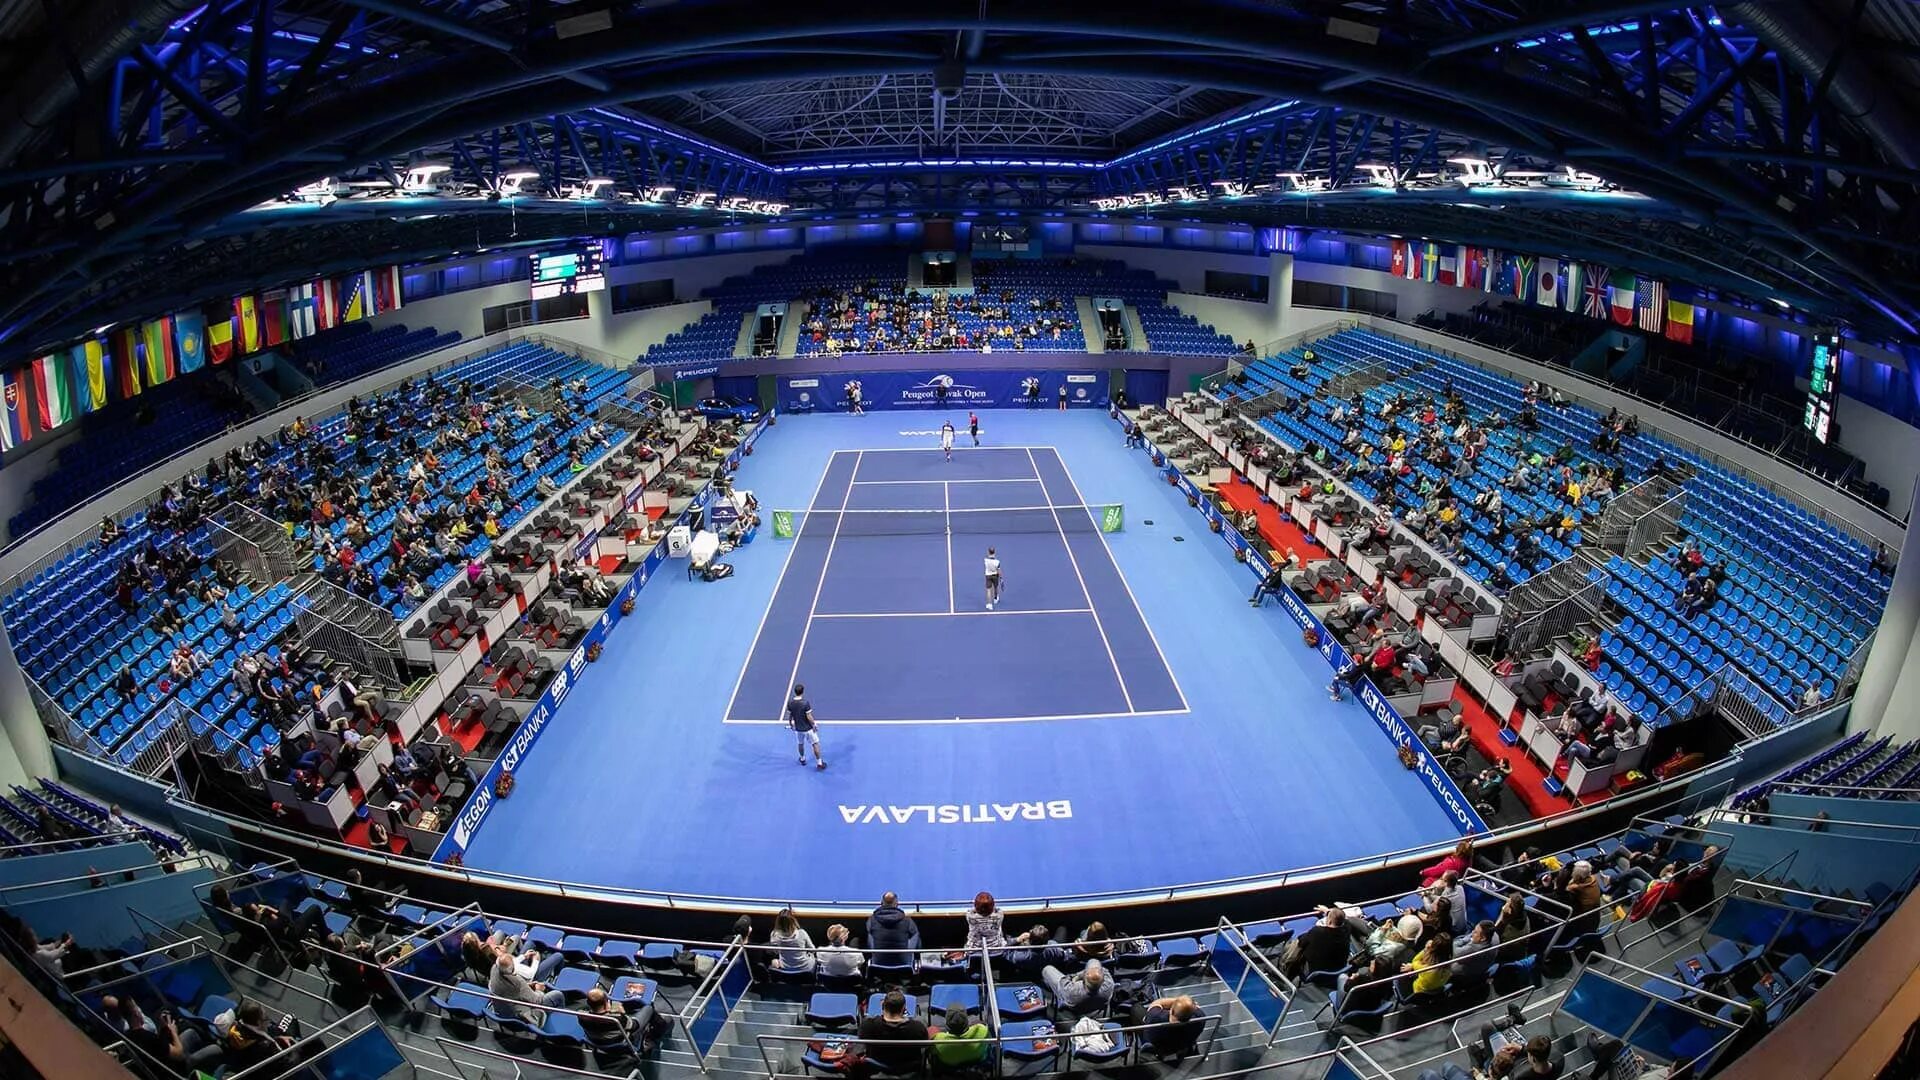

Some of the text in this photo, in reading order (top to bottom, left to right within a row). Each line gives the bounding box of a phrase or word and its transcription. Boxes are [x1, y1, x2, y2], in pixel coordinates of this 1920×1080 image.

[770, 305, 777, 314] C
[1104, 300, 1112, 309] C
[682, 367, 718, 377] PEUGEOT
[902, 390, 934, 399] Peugeot
[964, 389, 986, 399] Open
[517, 704, 549, 752] BANKA
[1424, 762, 1475, 830] PEUGEOT
[462, 786, 492, 834] AEGON
[838, 800, 1073, 823] BRATISLAVA
